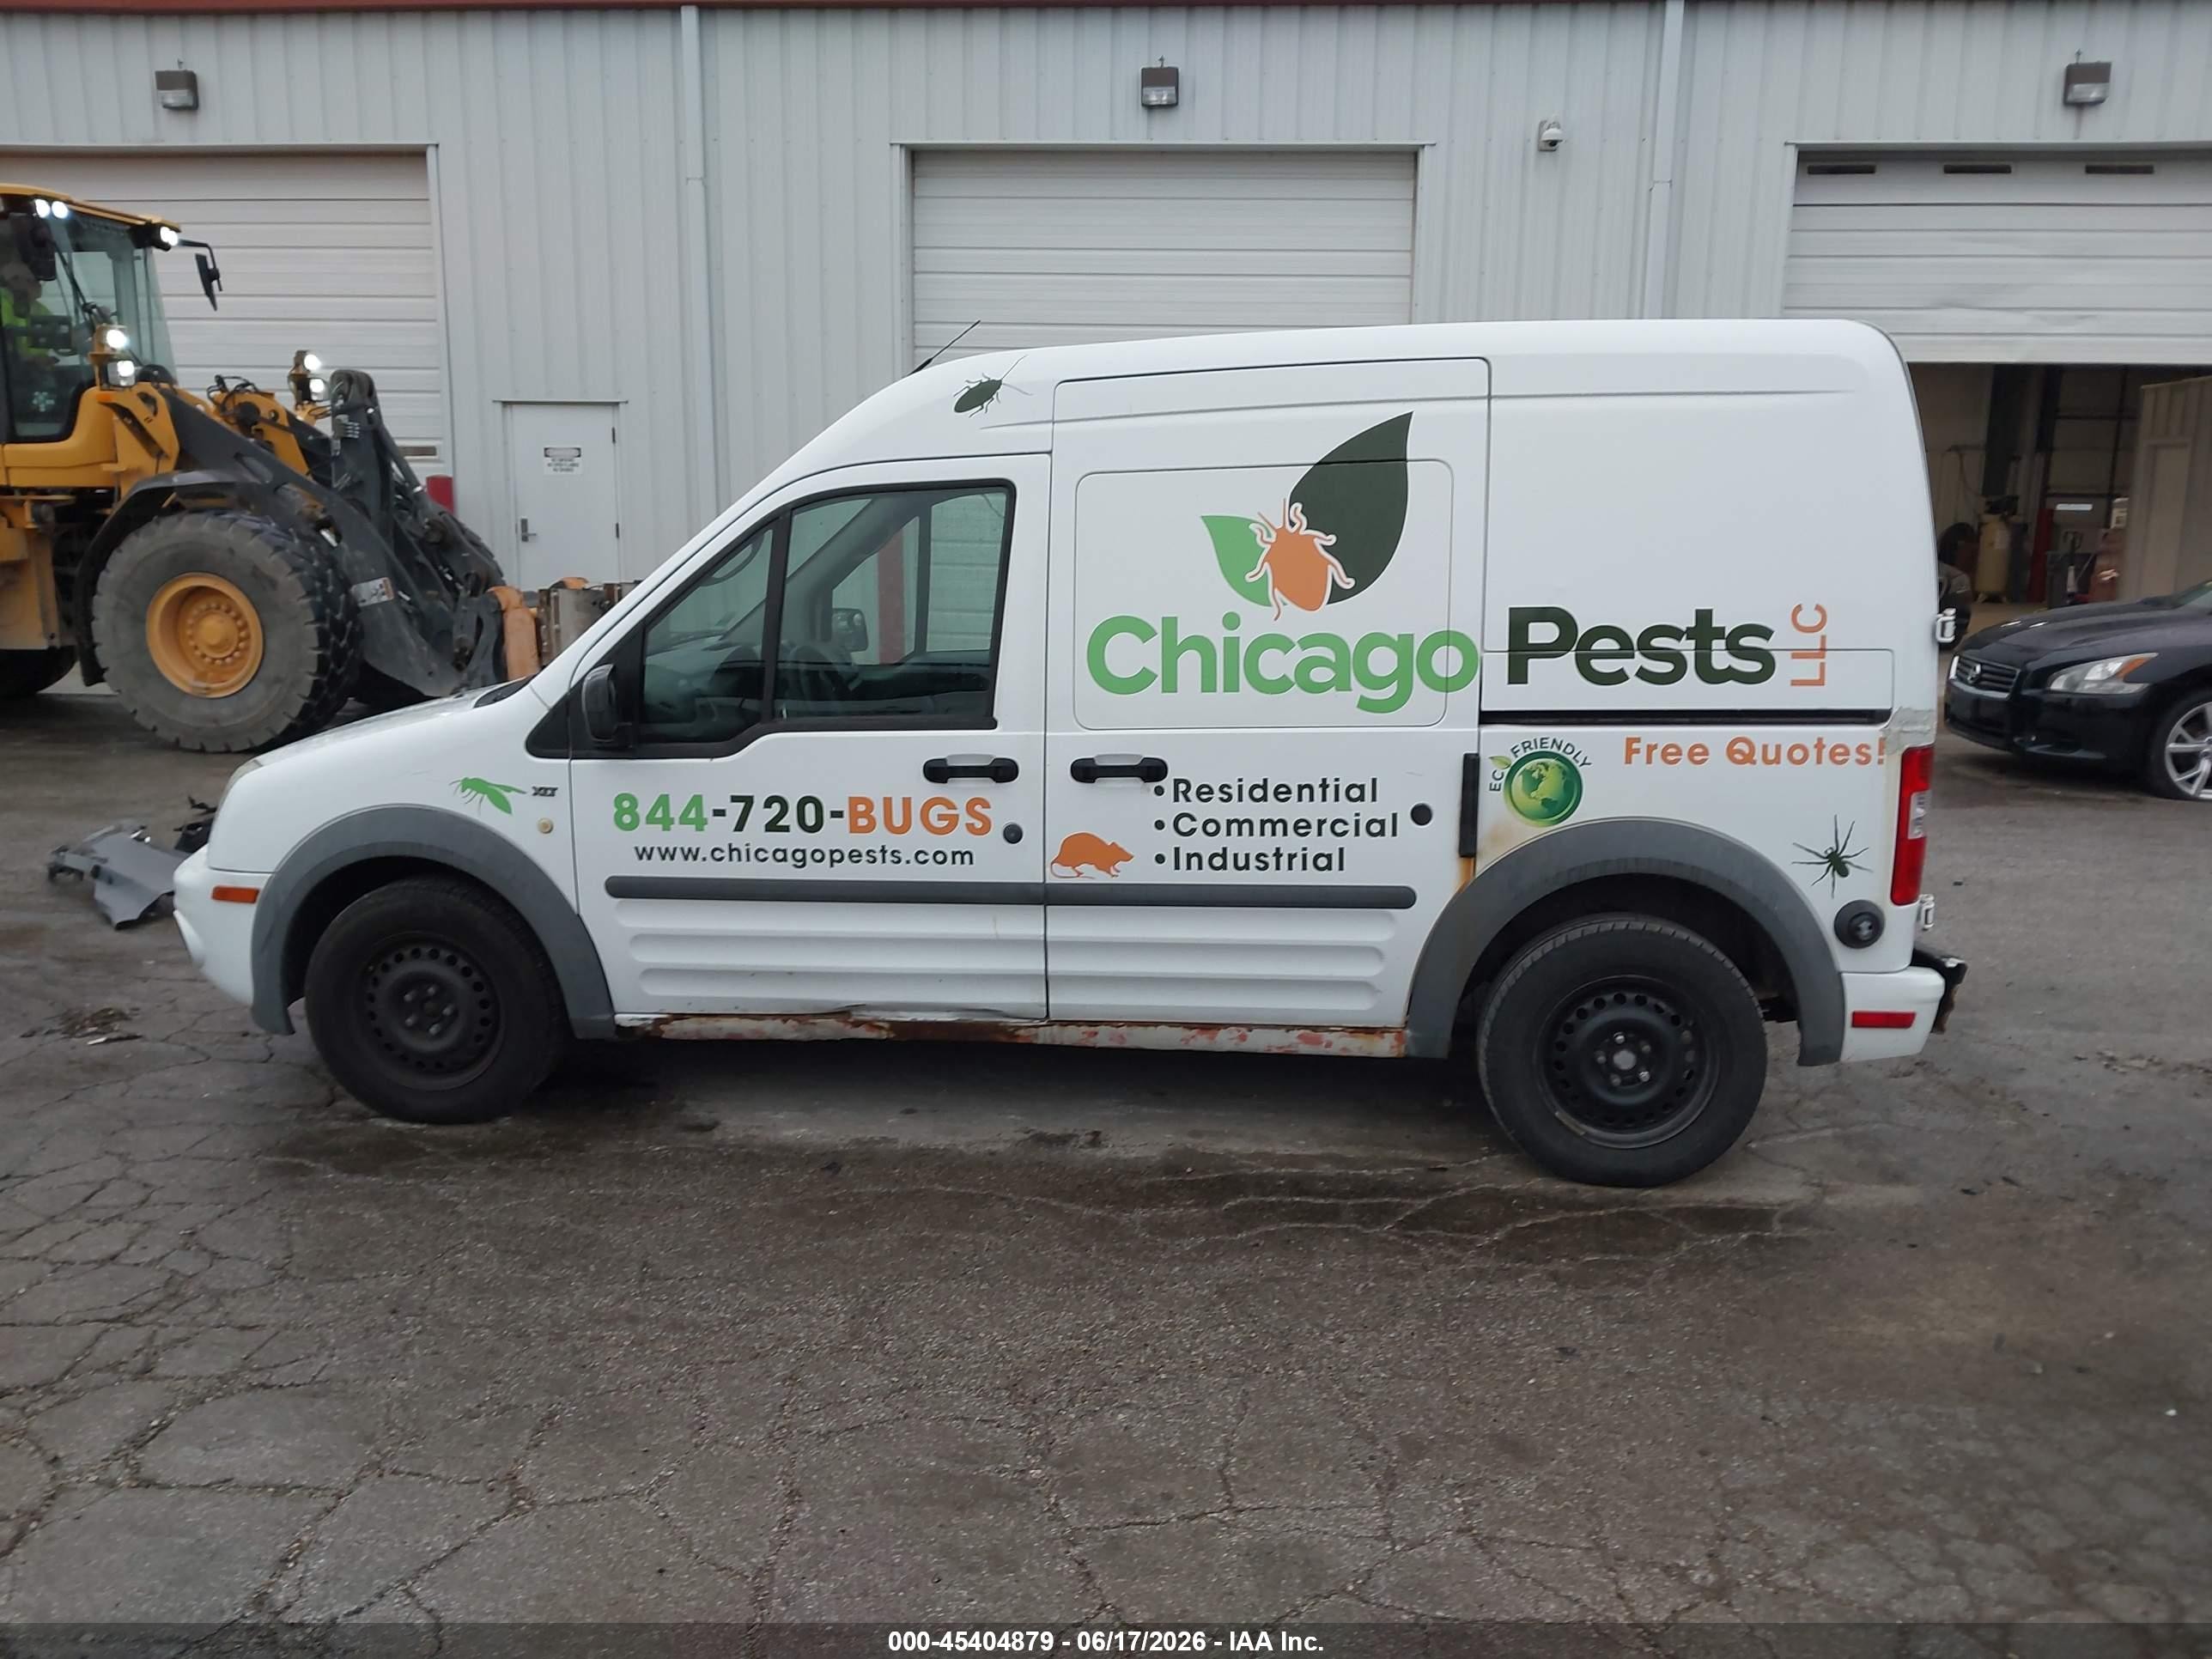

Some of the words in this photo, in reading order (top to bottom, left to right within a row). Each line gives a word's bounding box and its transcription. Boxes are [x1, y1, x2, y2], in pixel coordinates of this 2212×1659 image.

[1790, 603, 1827, 687] LLC
[1086, 611, 1479, 714] Chicago
[1506, 606, 1776, 686] Pests
[1510, 737, 1592, 768] FRIENDLY
[1624, 737, 1709, 765] Free
[1726, 736, 1887, 765] Quotes!
[1173, 777, 1377, 803] Residential
[613, 793, 992, 836] 844-720-BUGS
[1173, 812, 1398, 837] Commercial
[635, 842, 974, 868] www.chicagopests.com
[1173, 847, 1345, 872] Industrial
